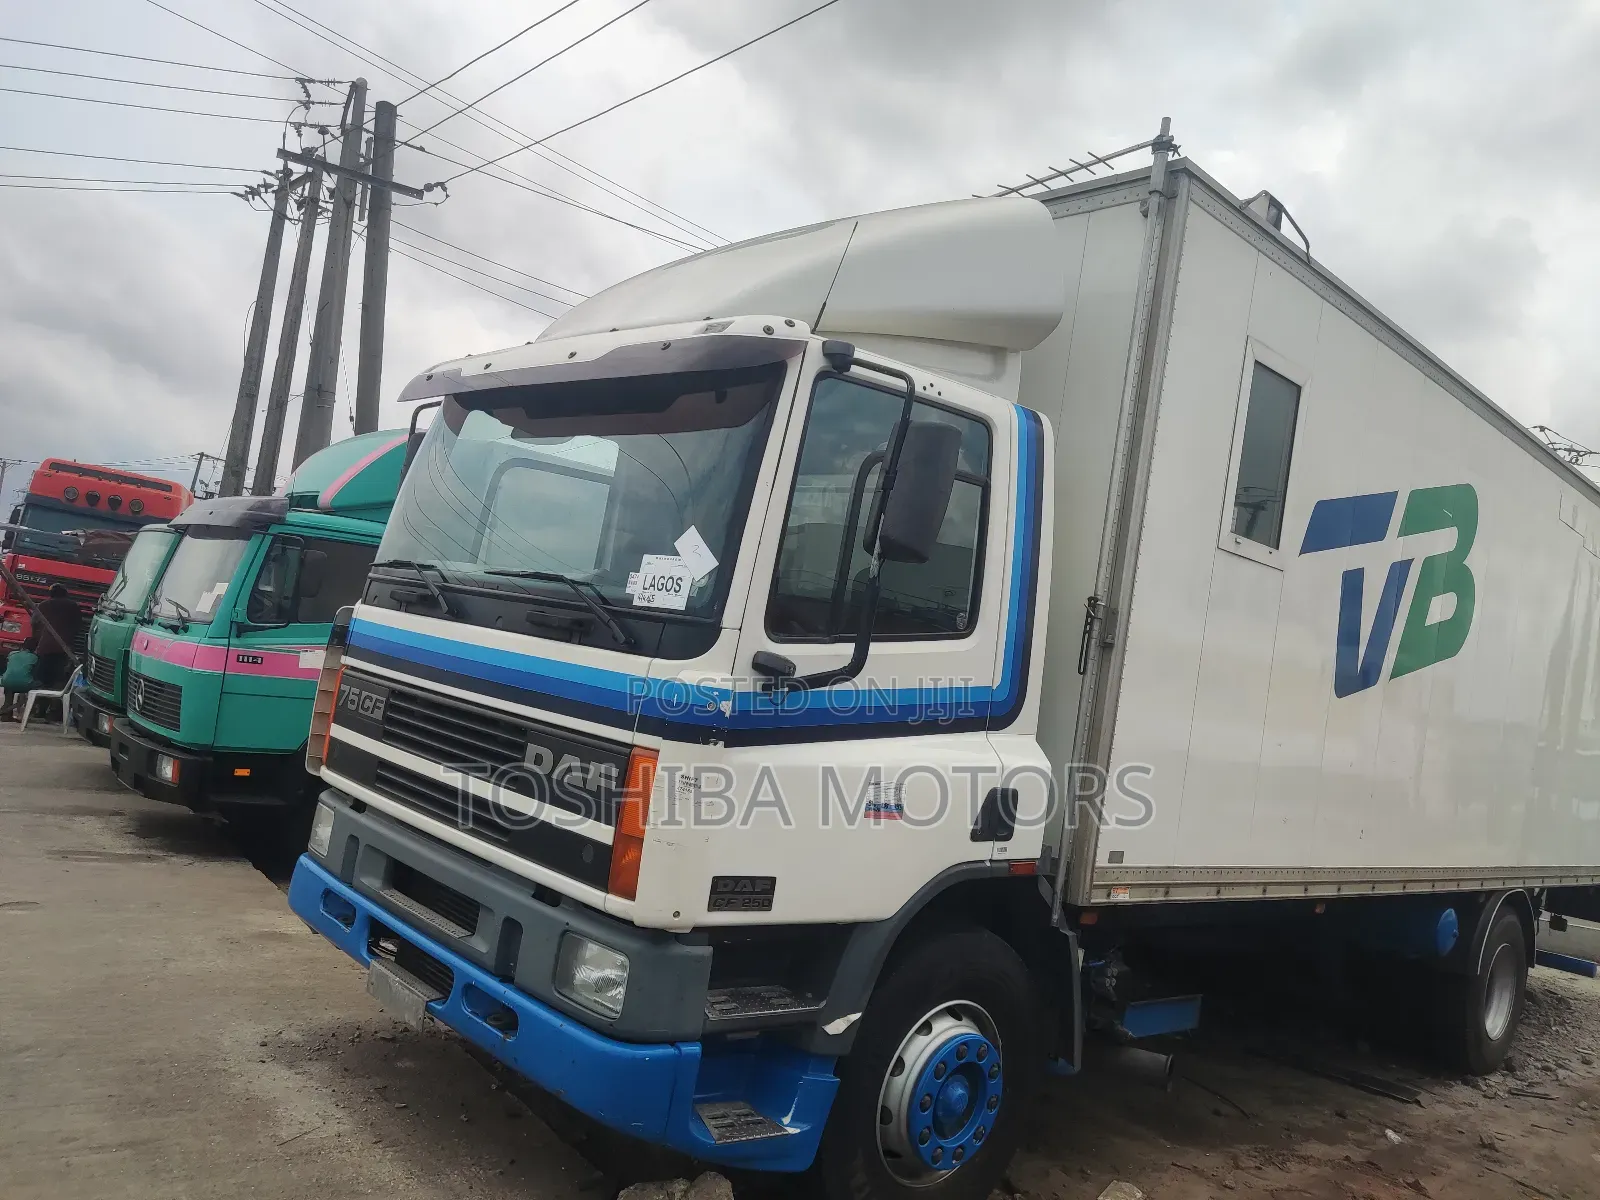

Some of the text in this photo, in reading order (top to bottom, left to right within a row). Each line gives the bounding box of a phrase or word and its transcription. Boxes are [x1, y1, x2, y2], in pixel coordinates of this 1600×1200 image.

[642, 574, 683, 594] LAGOS
[523, 742, 619, 792] DAF
[716, 878, 772, 892] DAF
[713, 897, 772, 909] CF 250
